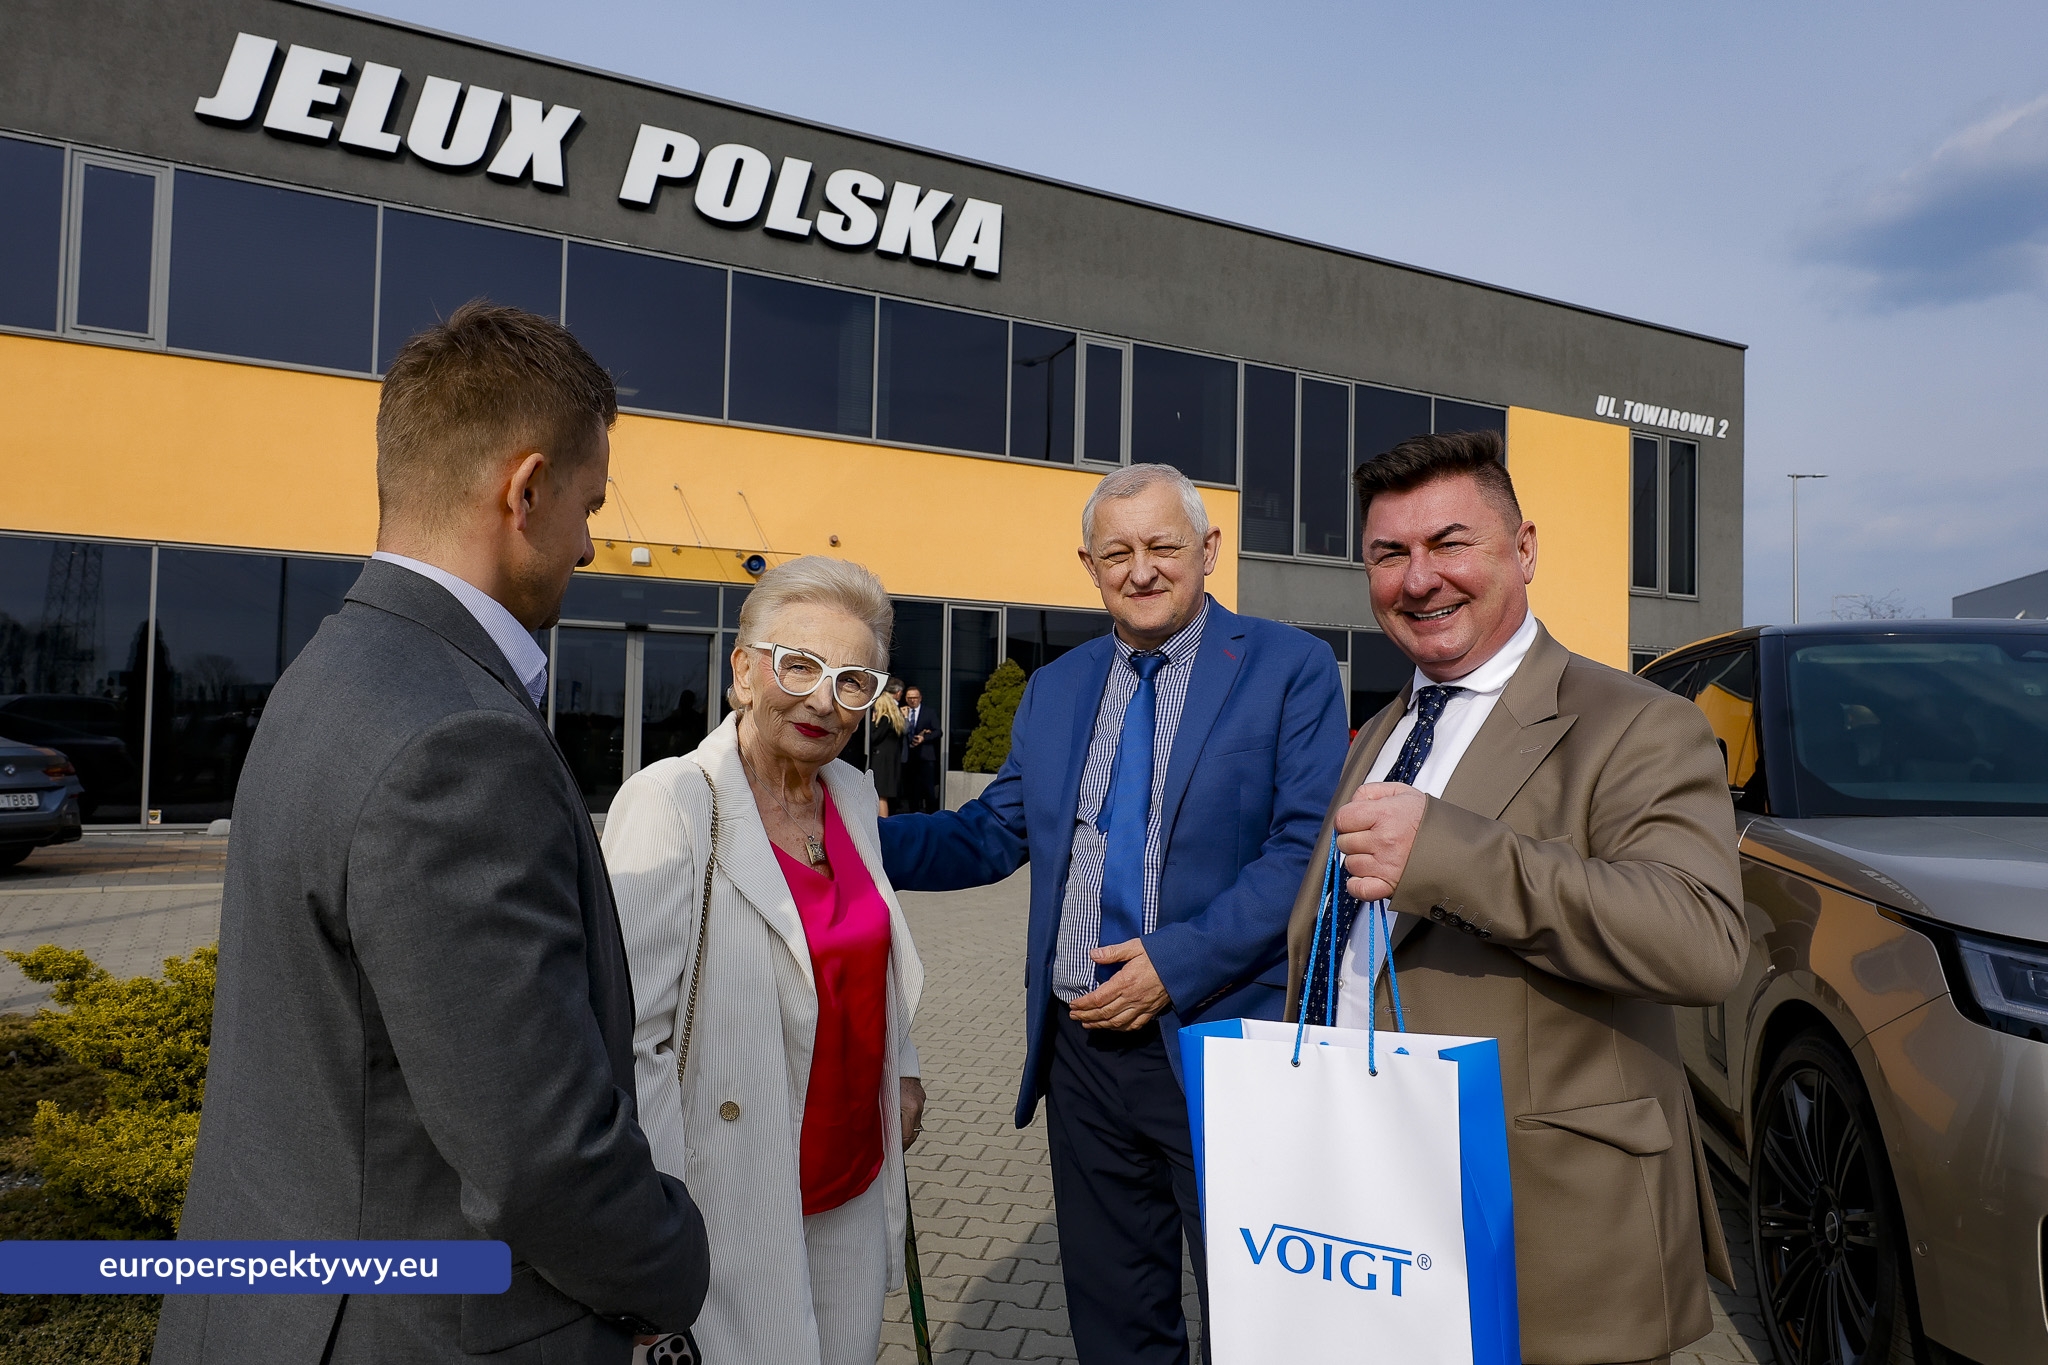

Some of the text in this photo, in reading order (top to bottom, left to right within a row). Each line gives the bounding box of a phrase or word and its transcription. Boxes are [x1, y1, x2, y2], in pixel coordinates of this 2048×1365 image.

[194, 32, 1004, 274] JELUX POLSKA
[1595, 394, 1730, 439] UL. TOWAROWA 2
